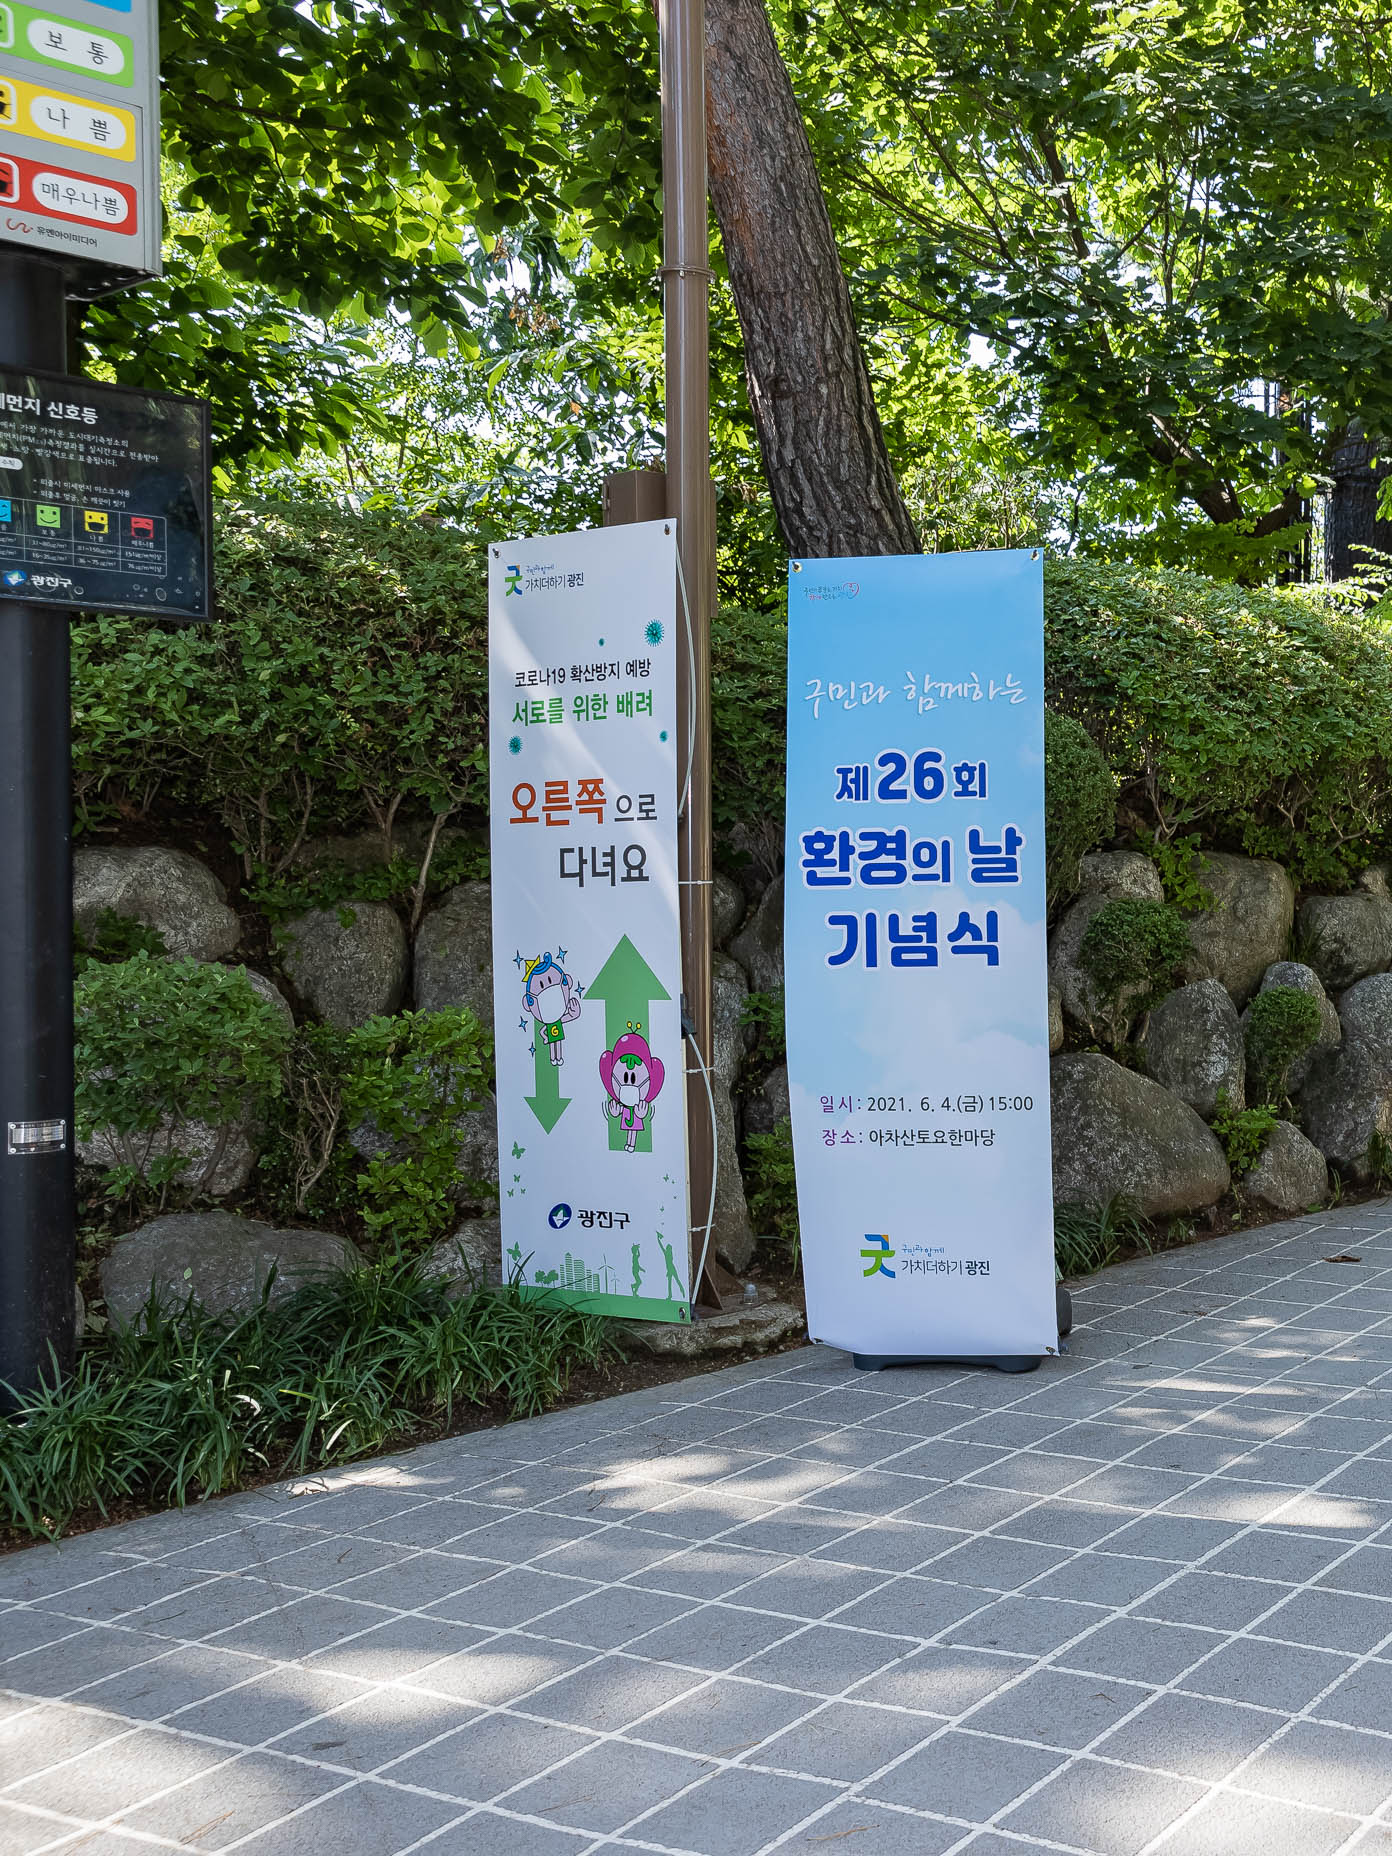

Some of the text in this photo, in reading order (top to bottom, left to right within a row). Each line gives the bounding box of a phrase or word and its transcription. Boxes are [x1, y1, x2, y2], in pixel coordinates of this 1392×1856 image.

[42, 182, 120, 217] 매우나쁨
[47, 401, 99, 425] 신호등
[31, 575, 72, 588] 광진구
[526, 572, 584, 591] 가치더하기 광진
[514, 657, 651, 688] 코로나19 확산방지 예방
[512, 688, 653, 727] 서로를 위한 배려
[805, 671, 1028, 719] 구민과 함께하는
[835, 750, 987, 802] 제26회
[509, 777, 658, 827] 오른쪽 으로
[559, 844, 650, 888] 다녀요
[802, 825, 1024, 887] 환경의 날
[827, 911, 1000, 969] 기념식
[867, 1097, 912, 1113] 2021.
[989, 1096, 1034, 1111] 15:00
[869, 1128, 996, 1147] 아차산토요한마당
[577, 1209, 631, 1229] 광진구
[901, 1259, 990, 1276] 가치더하기 광진
